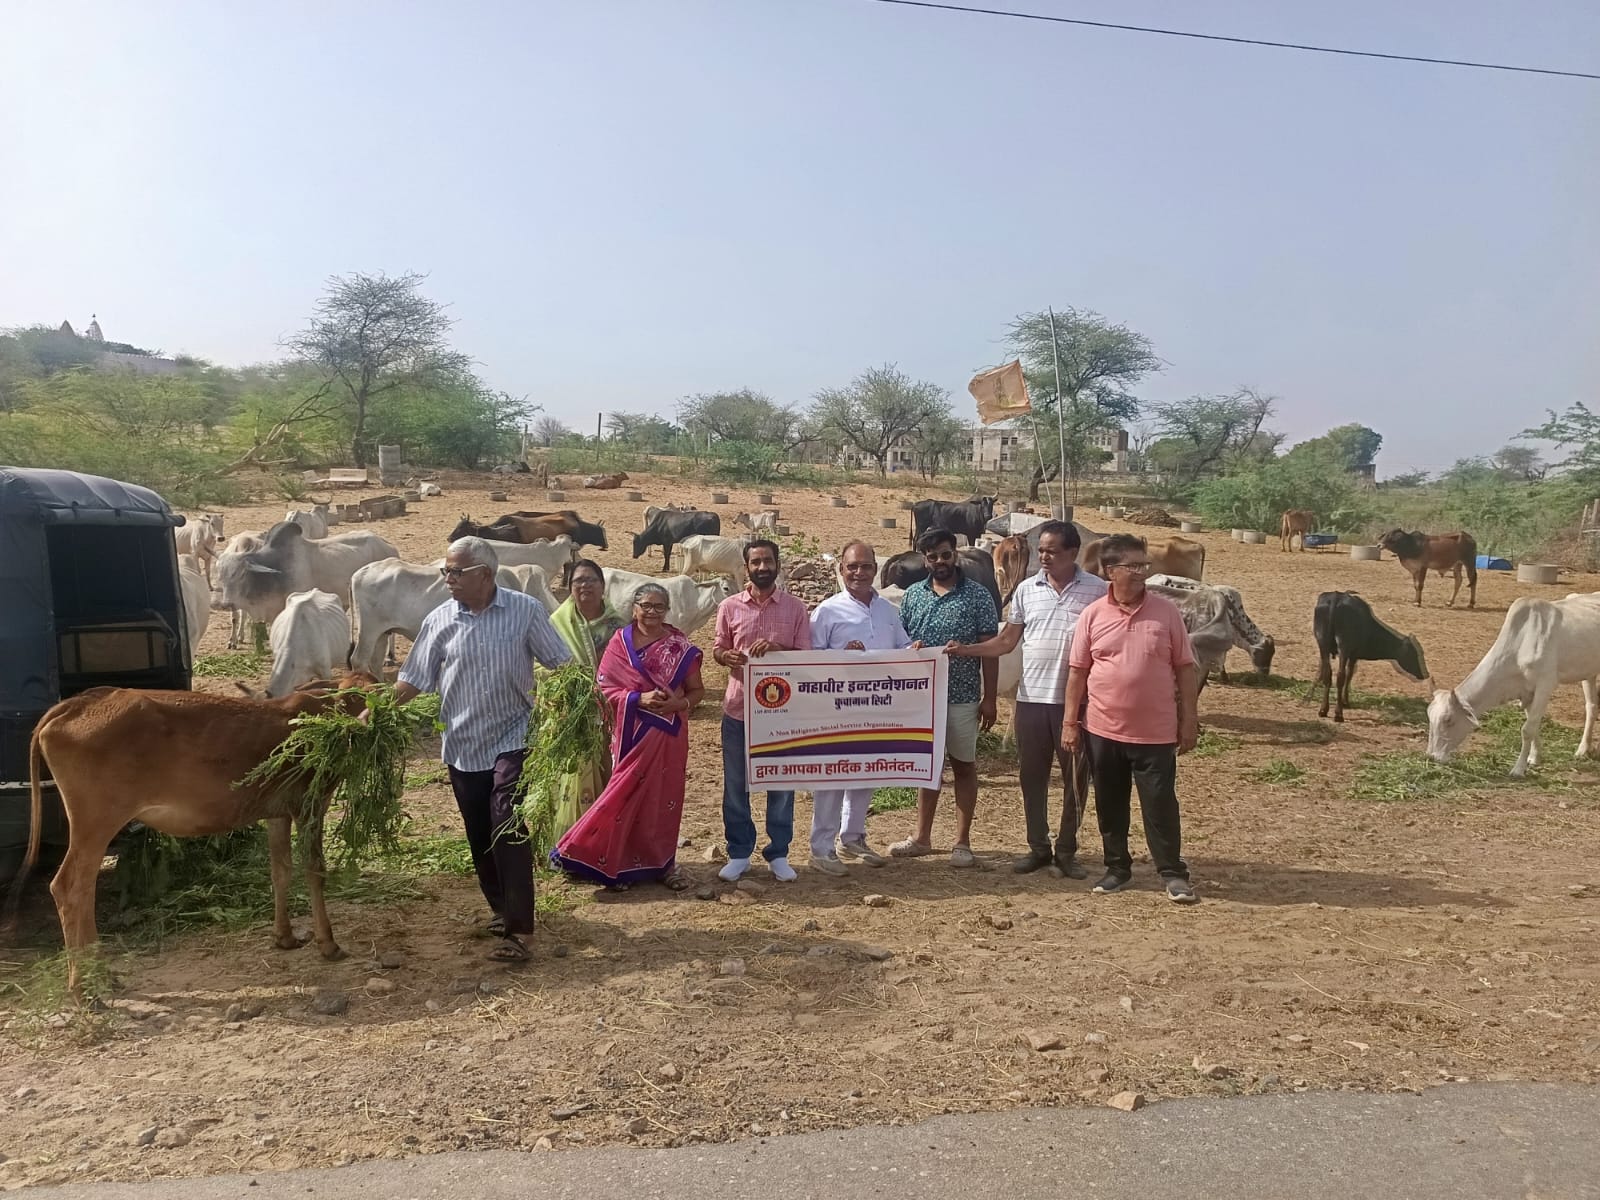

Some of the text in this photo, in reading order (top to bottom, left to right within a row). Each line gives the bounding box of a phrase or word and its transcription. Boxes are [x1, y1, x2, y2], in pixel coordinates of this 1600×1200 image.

[797, 675, 930, 693] महावीर इन्टरनेशनल
[871, 694, 892, 707] सिटी
[820, 723, 839, 732] Social
[755, 764, 778, 779] द्वारा
[781, 763, 822, 775] आपका
[823, 759, 861, 775] हार्दिक
